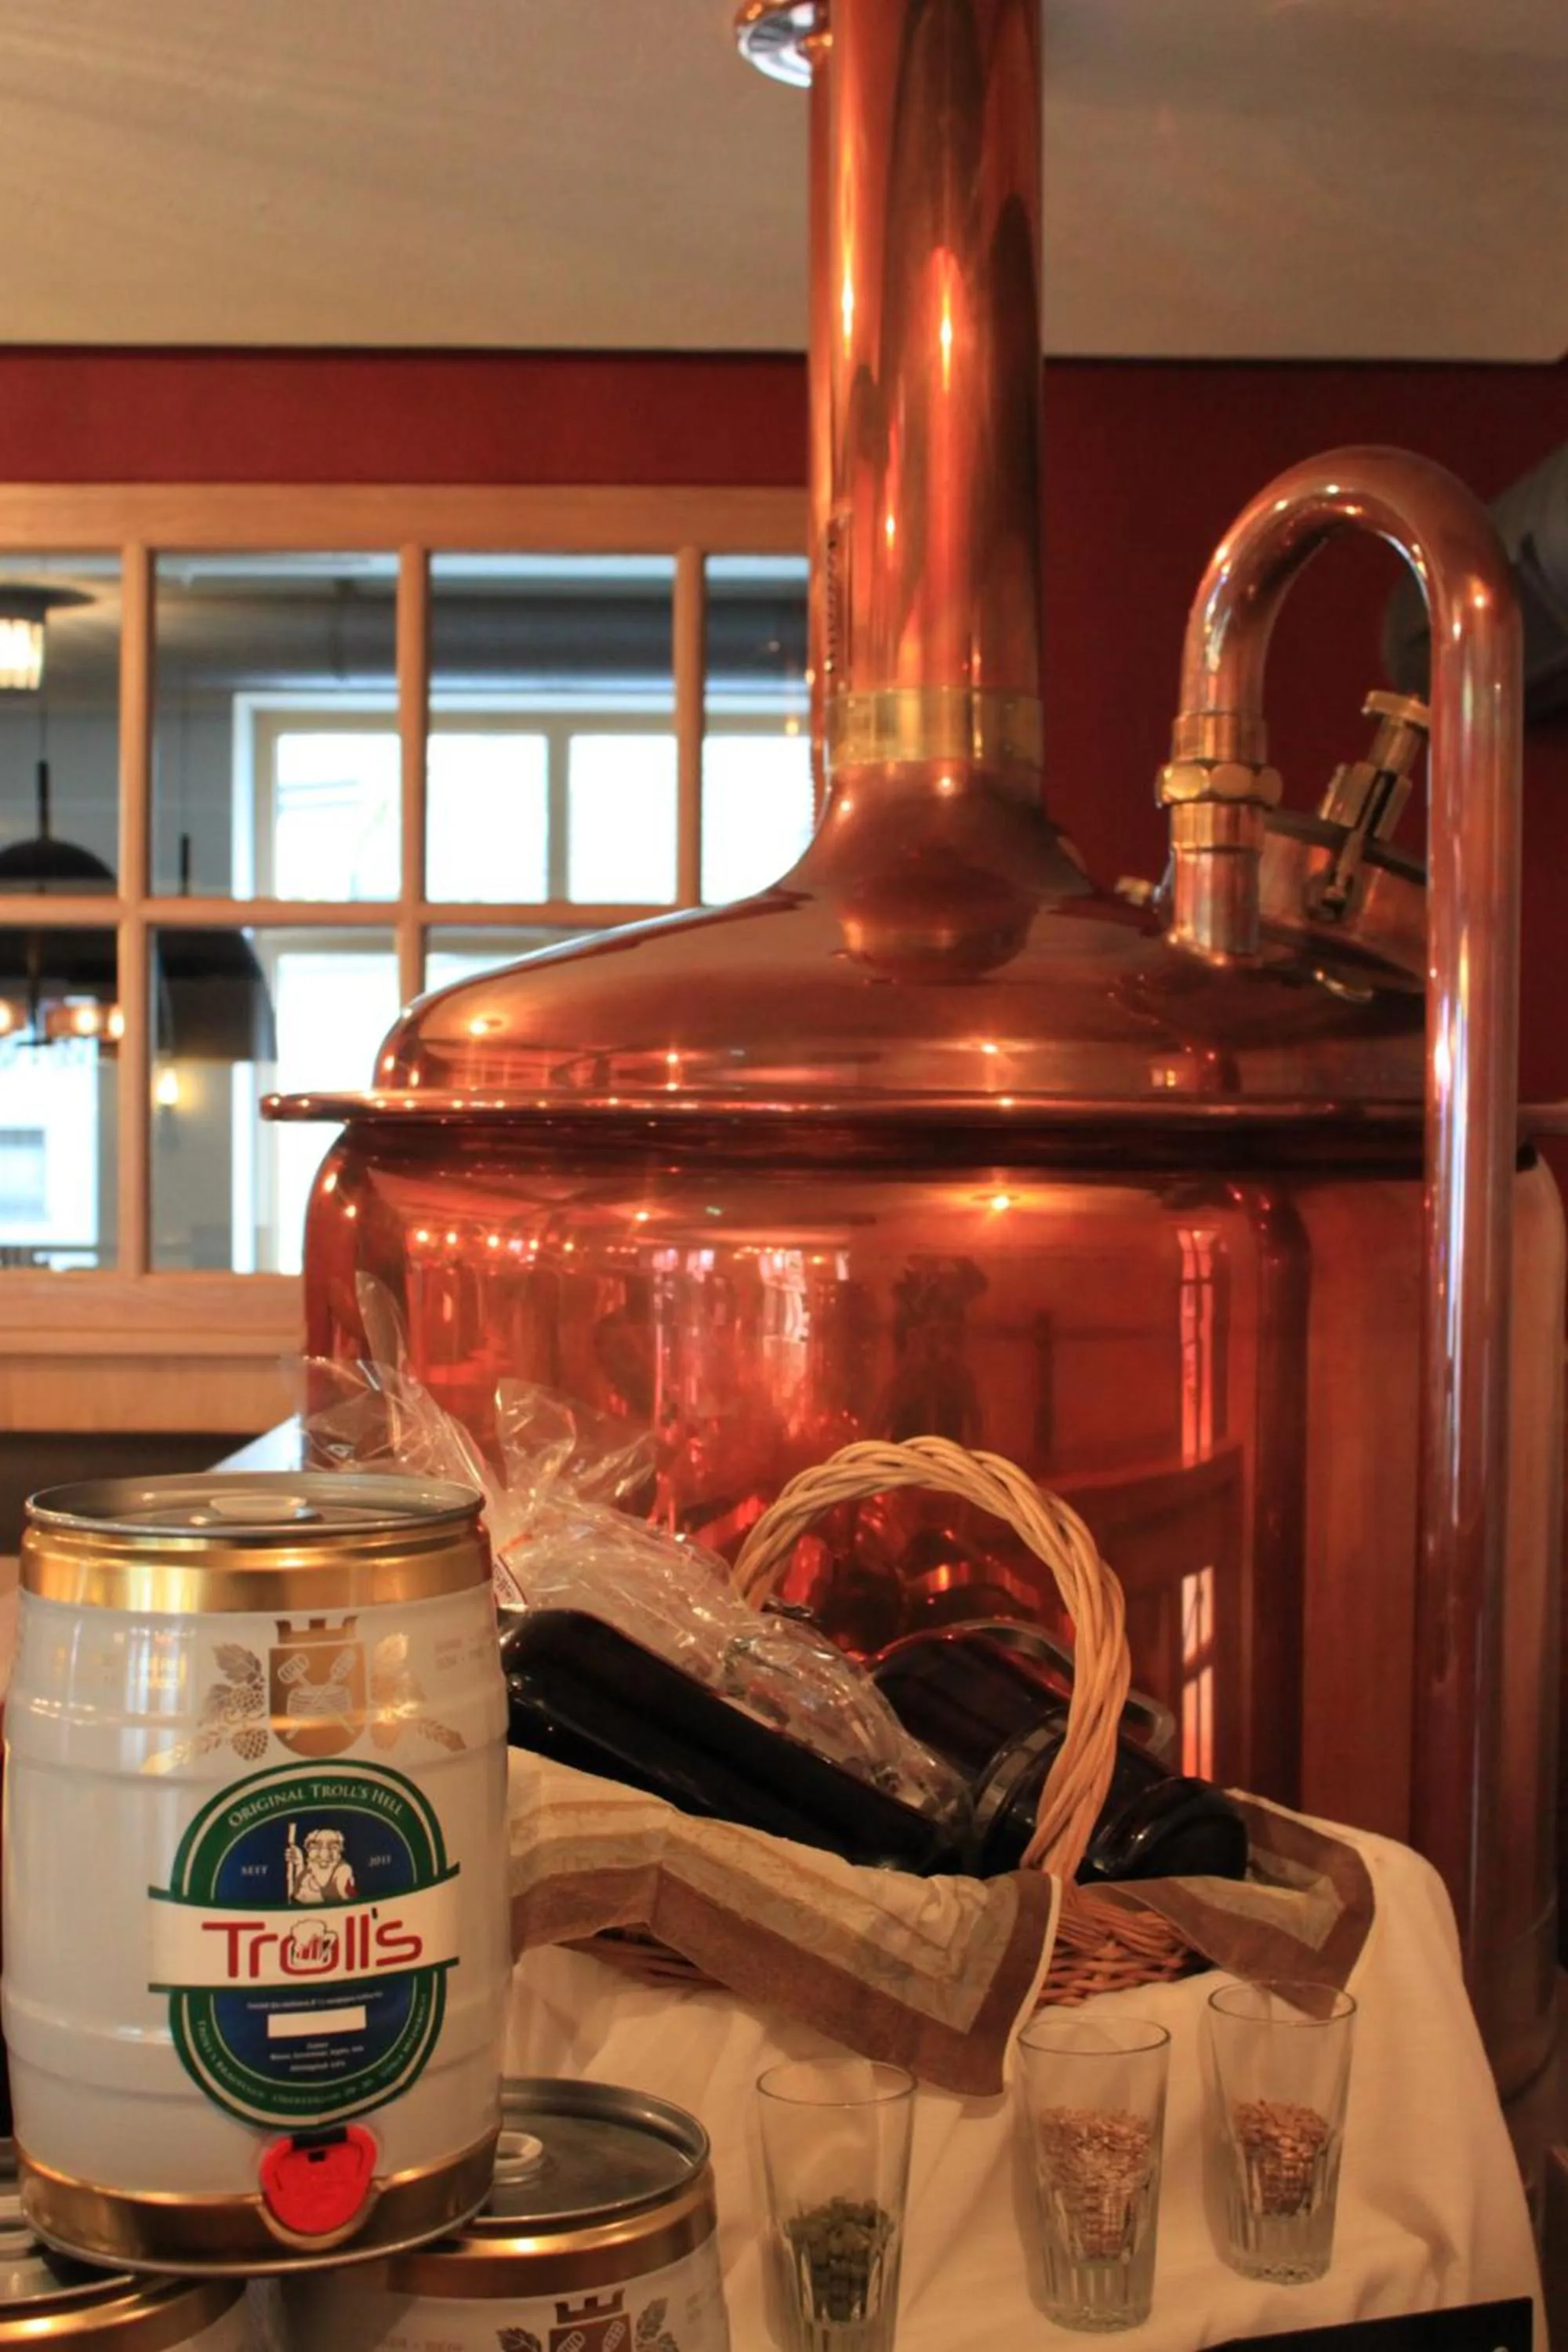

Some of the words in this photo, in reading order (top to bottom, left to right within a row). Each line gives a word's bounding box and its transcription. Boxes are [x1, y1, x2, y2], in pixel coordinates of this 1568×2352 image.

[229, 1789, 304, 1827] ORIGINAL
[310, 1784, 368, 1799] TROLL'S
[372, 1788, 403, 1815] HILL
[201, 1907, 423, 1978] Troll's
